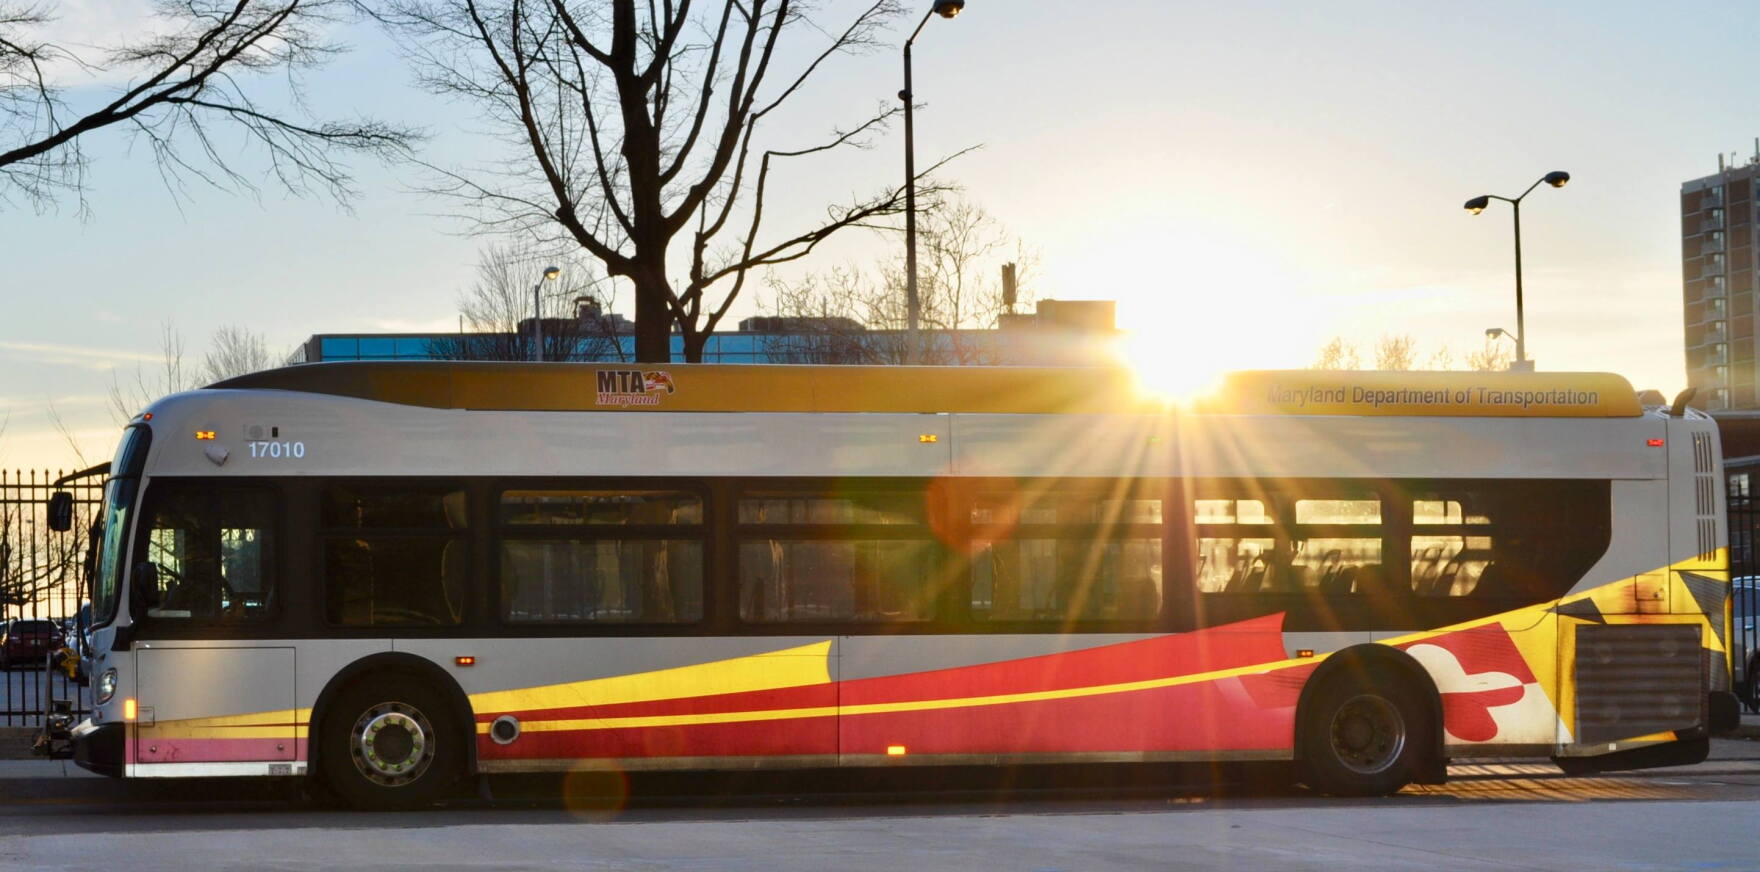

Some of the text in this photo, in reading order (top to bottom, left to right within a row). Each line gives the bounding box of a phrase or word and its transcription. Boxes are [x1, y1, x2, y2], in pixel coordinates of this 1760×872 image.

[597, 371, 645, 393] MTA
[595, 393, 660, 407] Maryland
[1267, 385, 1598, 408] Maryland Department of Transportation
[248, 441, 305, 458] 17010
